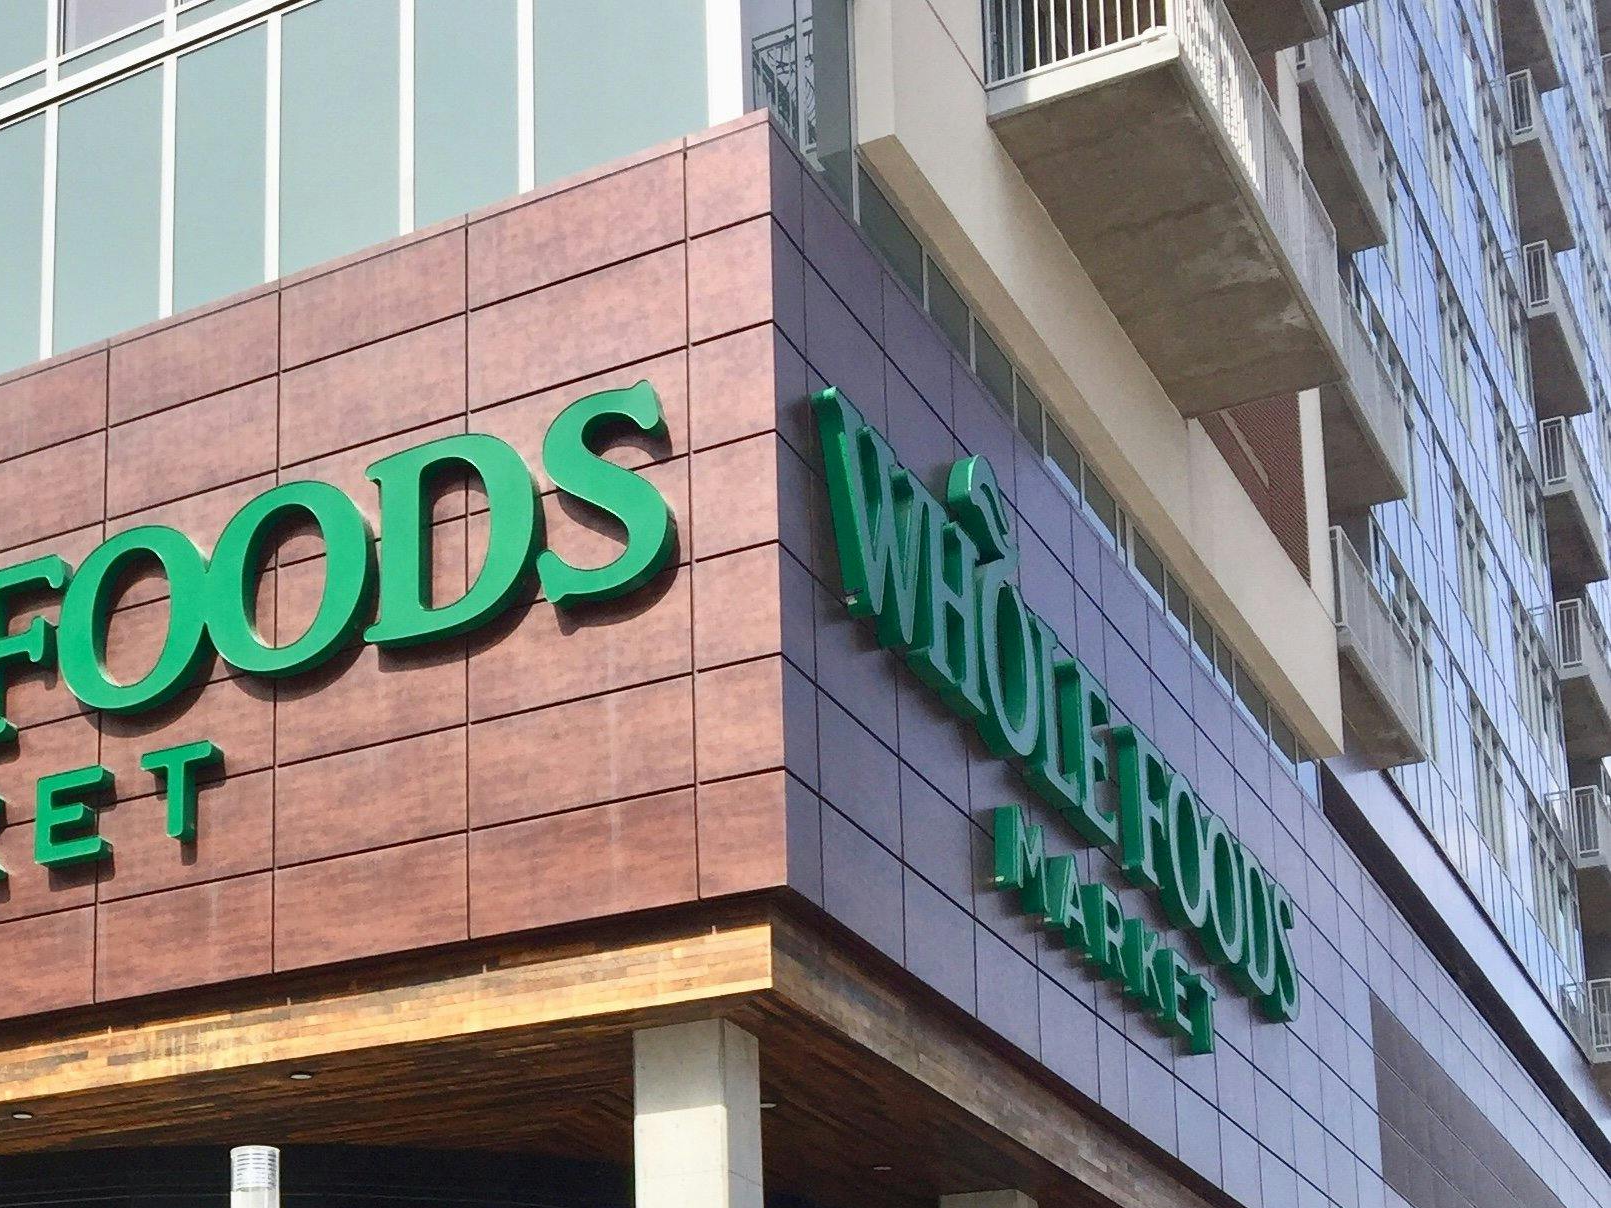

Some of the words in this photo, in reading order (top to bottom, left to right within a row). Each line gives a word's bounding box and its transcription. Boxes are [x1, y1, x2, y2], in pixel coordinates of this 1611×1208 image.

[811, 386, 1119, 848] WHOLE
[1112, 725, 1299, 1023] FOODS
[993, 804, 1217, 1054] MARKET
